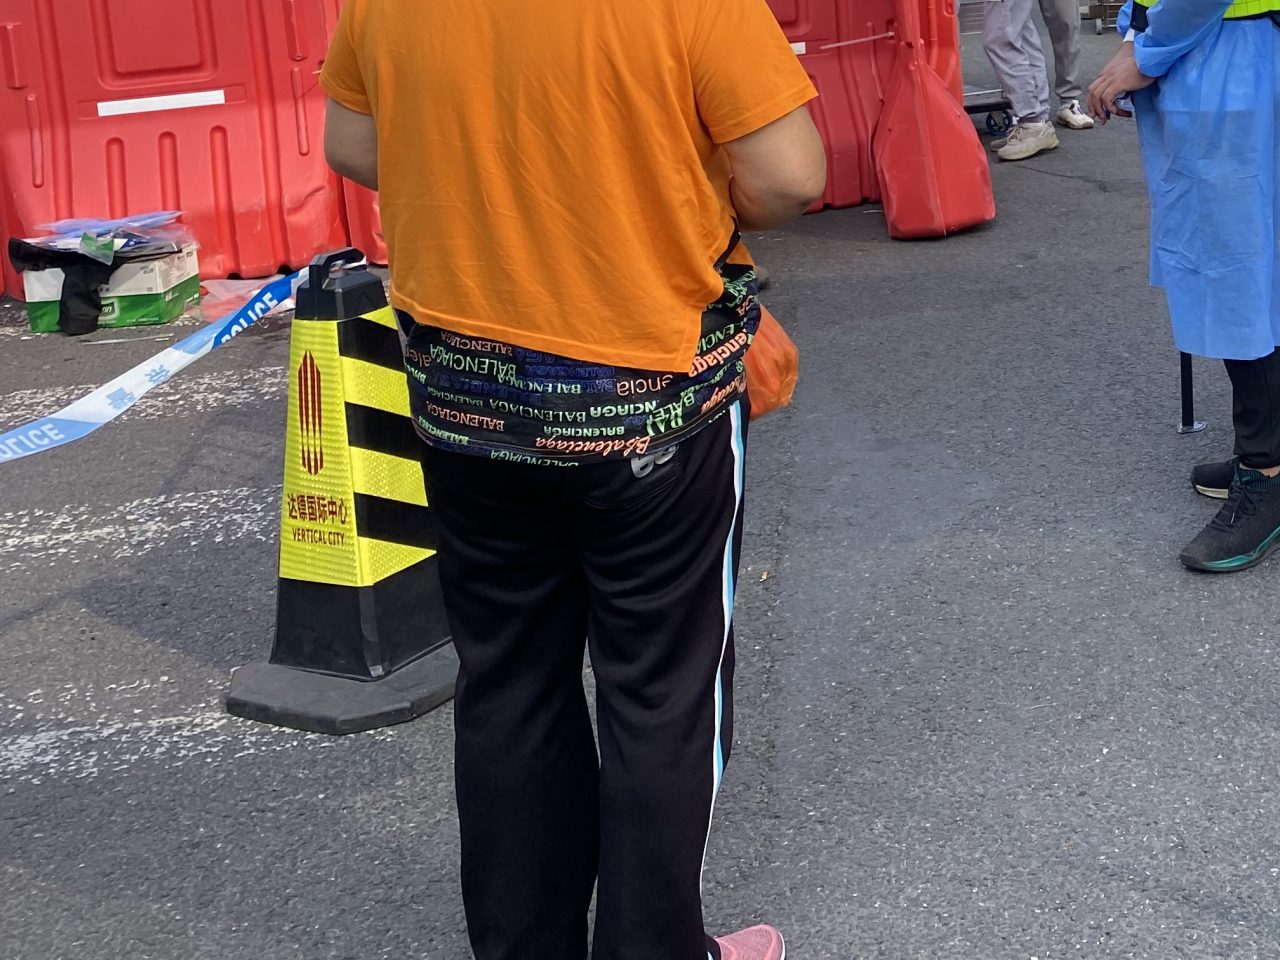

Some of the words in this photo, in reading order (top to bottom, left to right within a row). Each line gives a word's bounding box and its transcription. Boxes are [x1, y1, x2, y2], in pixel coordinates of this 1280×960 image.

[489, 398, 587, 423] BALENCIAGA
[543, 425, 626, 438] BALENCIAGA
[292, 527, 328, 545] VERTICAL
[328, 531, 345, 547] CITY
